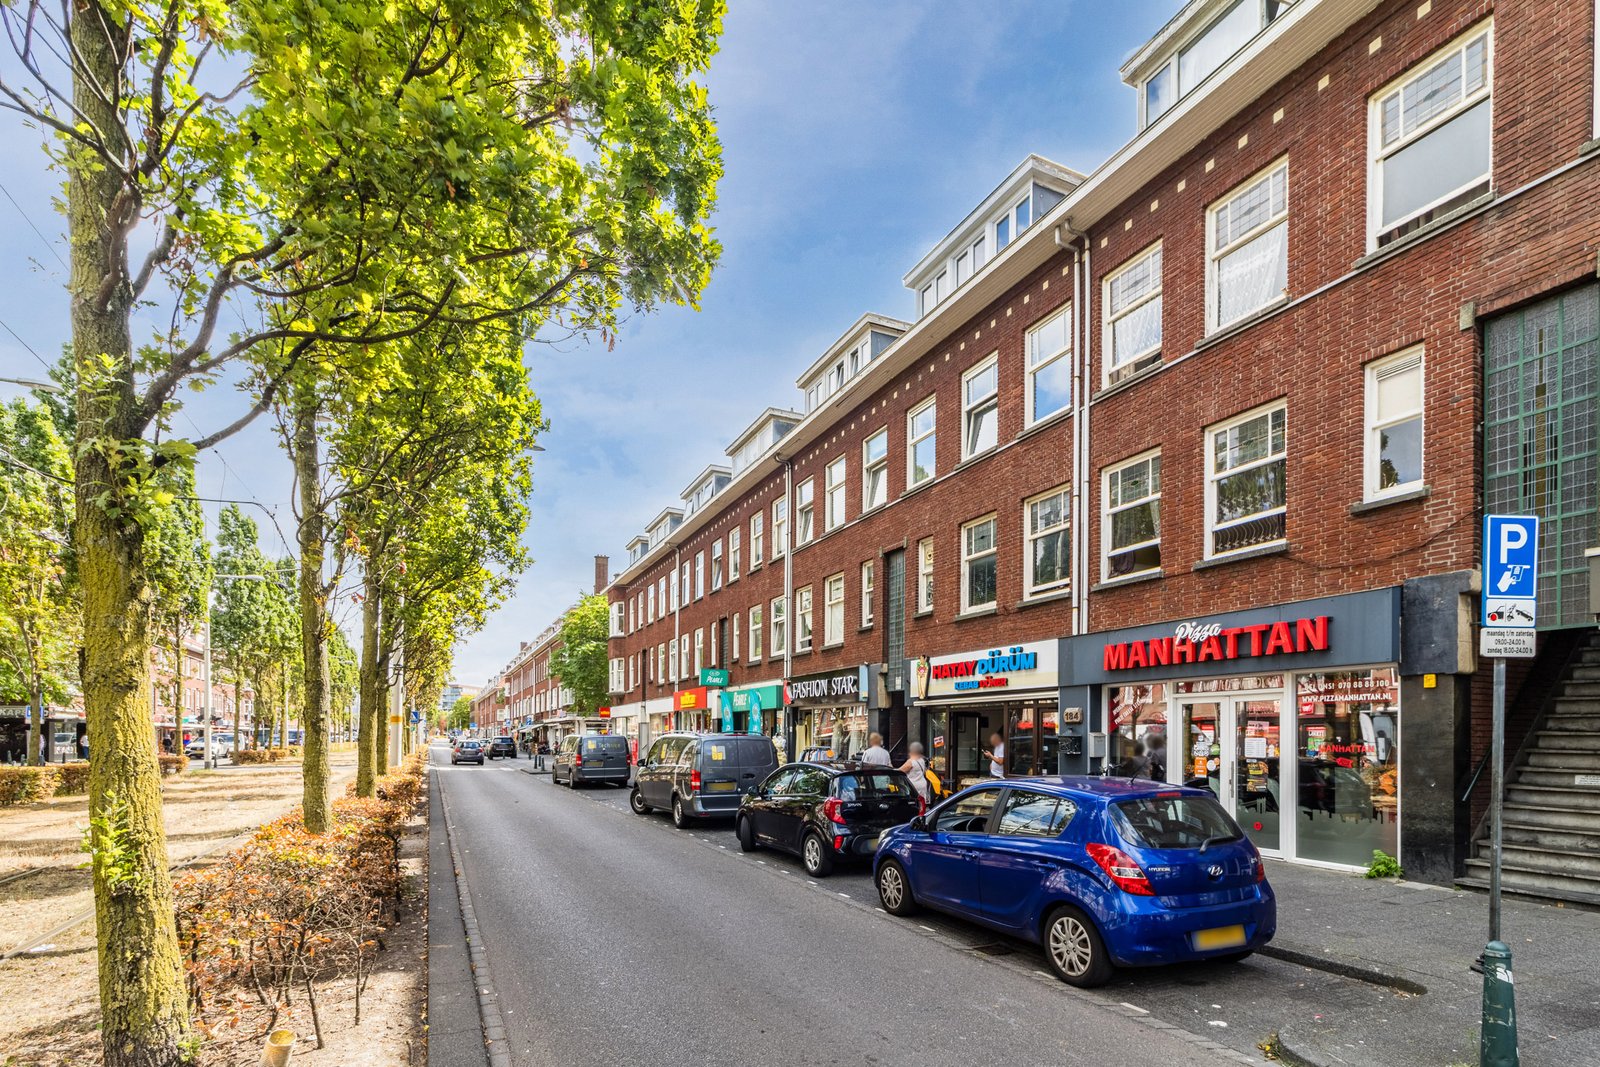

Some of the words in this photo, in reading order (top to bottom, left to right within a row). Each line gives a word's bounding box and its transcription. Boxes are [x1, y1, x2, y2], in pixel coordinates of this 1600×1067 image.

[1500, 523, 1528, 564] P
[1174, 621, 1222, 645] Pizza
[1103, 616, 1328, 671] MANHATTAN
[1487, 647, 1502, 655] zondag
[932, 660, 976, 679] HATAY
[978, 646, 1038, 675] DÜRÜM
[792, 679, 828, 699] FASHION
[831, 675, 856, 696] STAR
[954, 680, 979, 691] KEBAB
[1337, 682, 1351, 690] 070
[1352, 681, 1363, 689] 88
[1364, 680, 1375, 688] 88
[1376, 679, 1390, 688] 100
[1302, 692, 1393, 703] WWW.PIZZAMANHATTAN.NL
[1064, 711, 1079, 721] 184
